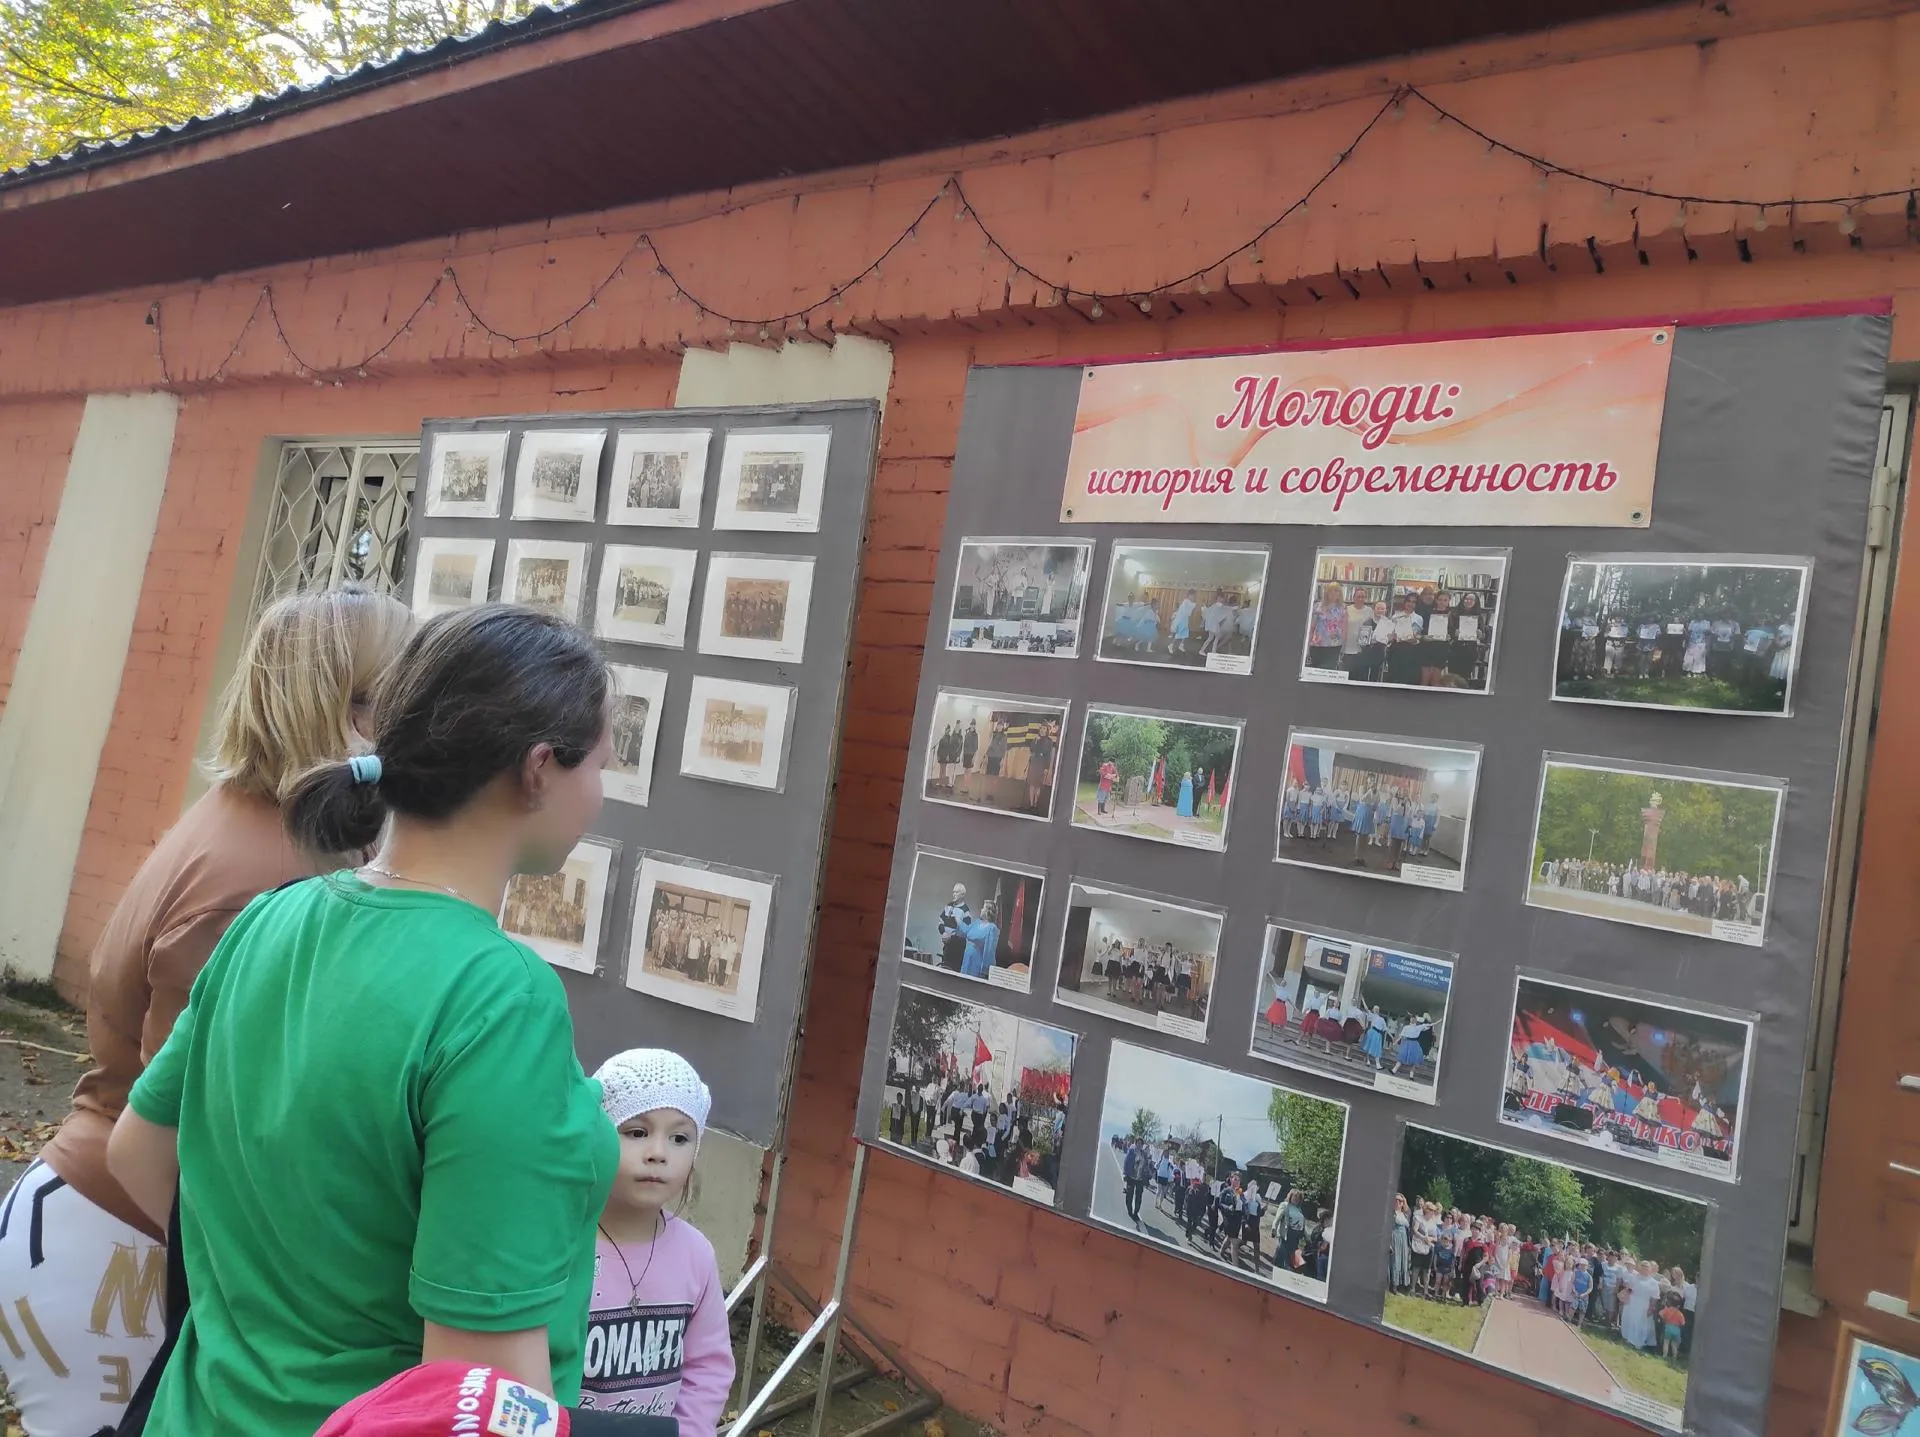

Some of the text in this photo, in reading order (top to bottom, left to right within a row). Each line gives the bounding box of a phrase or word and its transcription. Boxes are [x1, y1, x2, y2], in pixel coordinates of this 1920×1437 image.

[1216, 376, 1458, 449] Молоди:
[1086, 457, 1618, 512] история и современность
